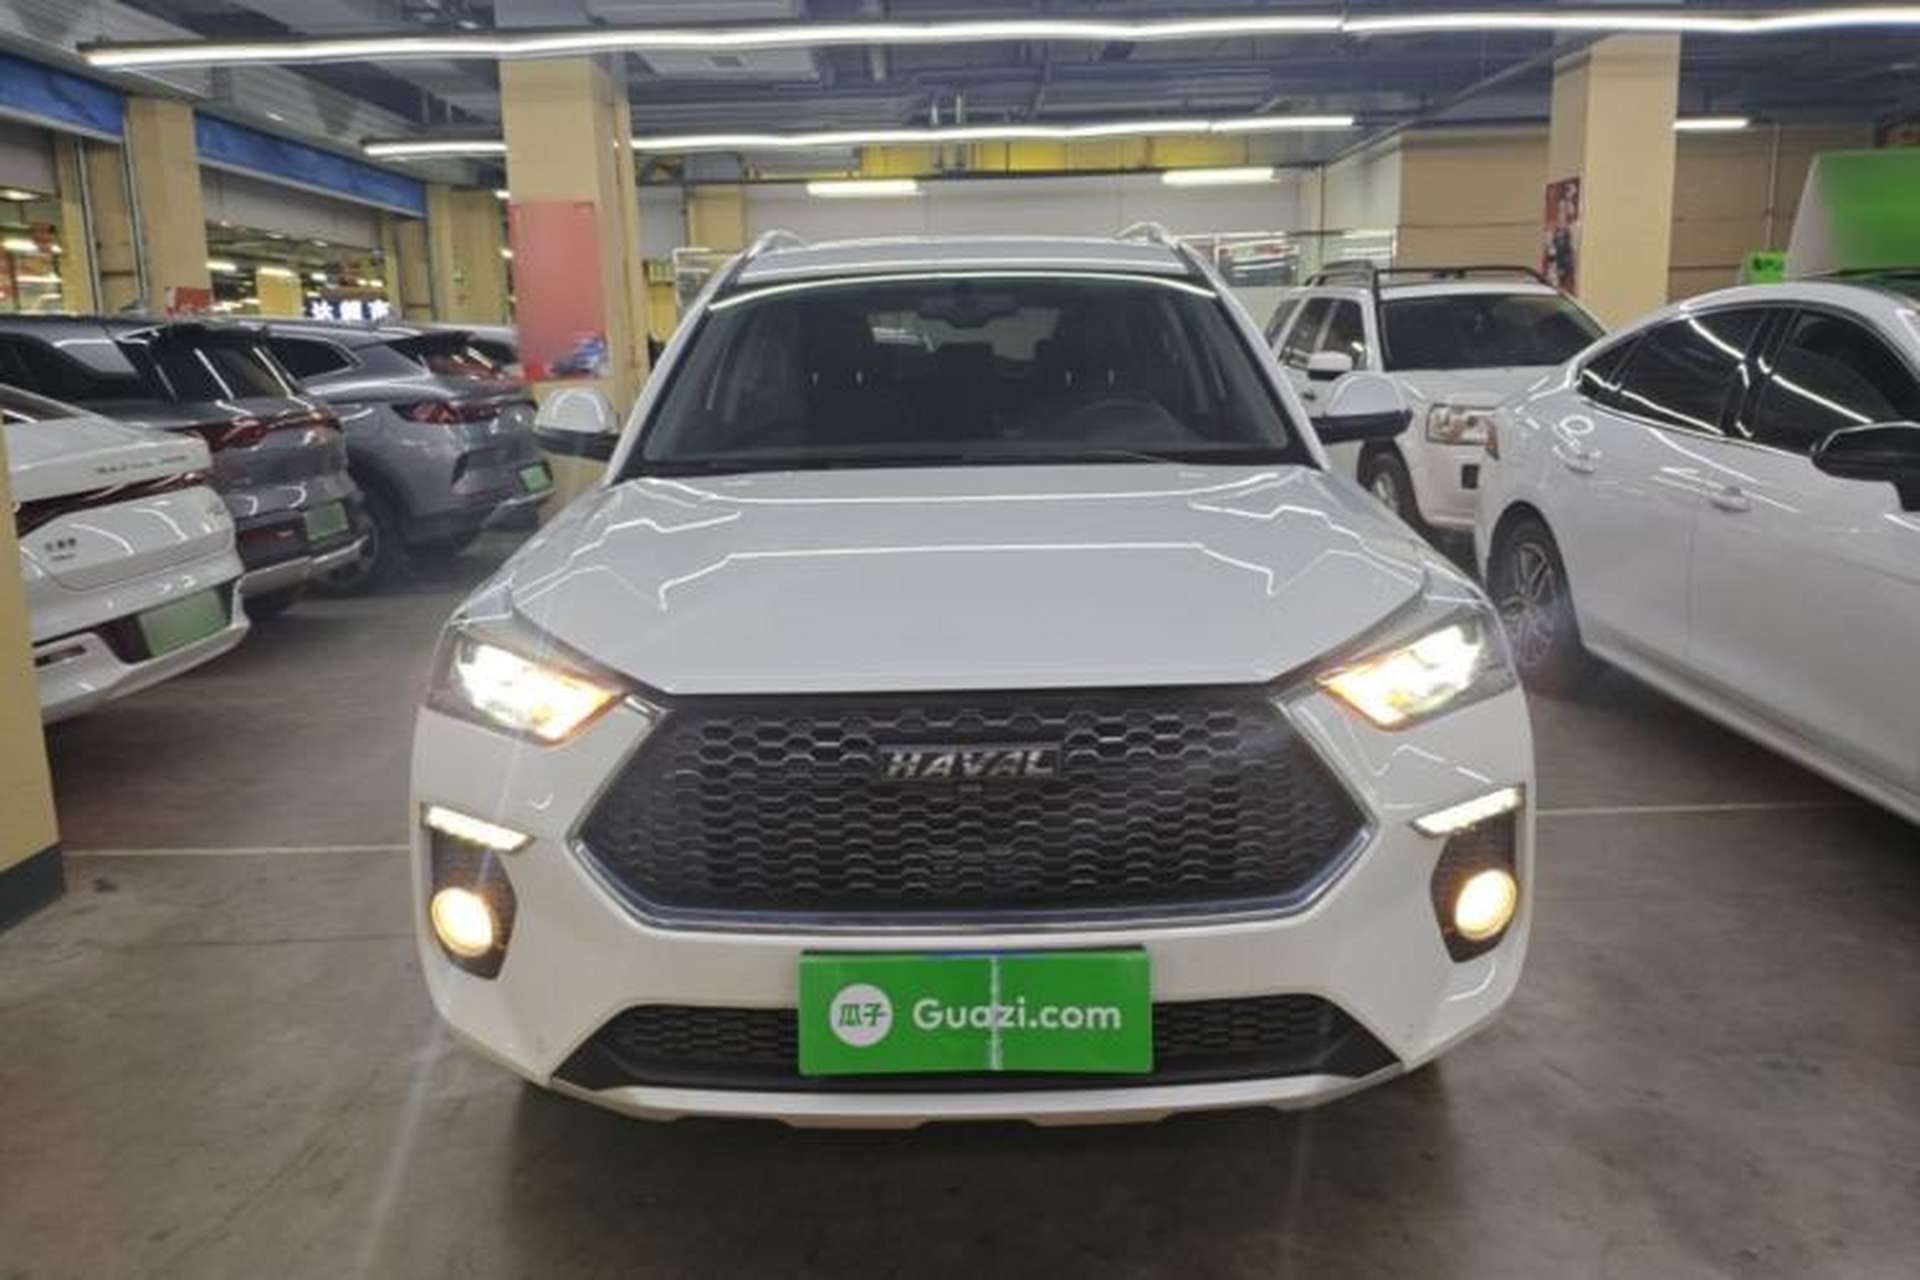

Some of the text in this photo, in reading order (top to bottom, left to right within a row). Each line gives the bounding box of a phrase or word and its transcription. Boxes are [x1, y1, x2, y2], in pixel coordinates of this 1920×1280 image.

[886, 751, 1054, 778] HAVAL
[839, 1003, 886, 1028] 瓜子
[912, 996, 1122, 1030] Guazi.com
